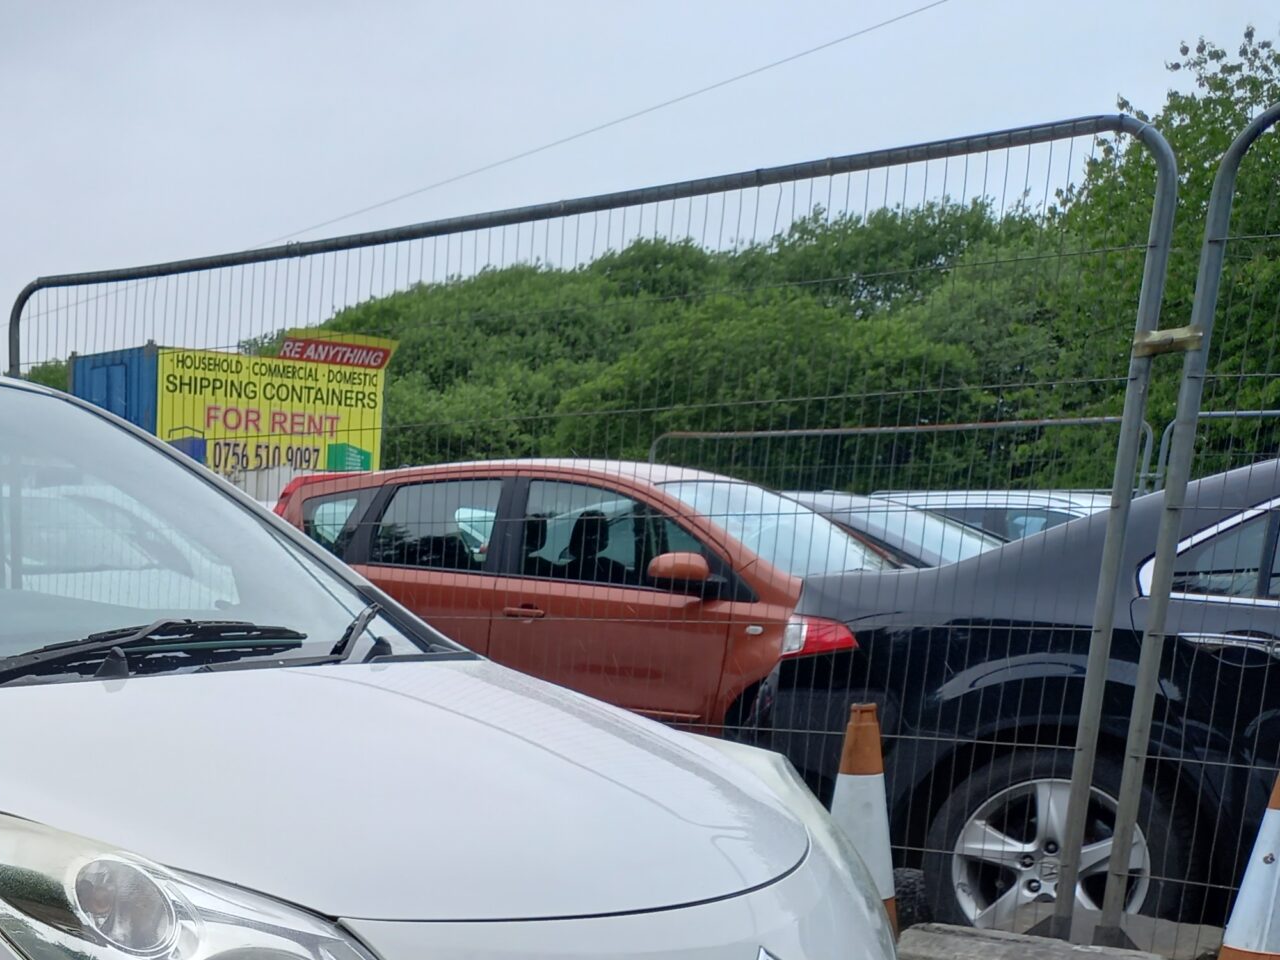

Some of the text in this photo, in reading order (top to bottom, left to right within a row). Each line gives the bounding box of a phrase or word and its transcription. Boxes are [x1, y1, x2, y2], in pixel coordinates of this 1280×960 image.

[304, 343, 384, 366] ANYTHING
[176, 354, 378, 388] HOUSEHOLD COMMERCIAL DOMESTIC
[166, 374, 377, 409] SHIPPING CONTAINERS
[206, 406, 340, 437] FOR RENT
[213, 442, 249, 470] 0756
